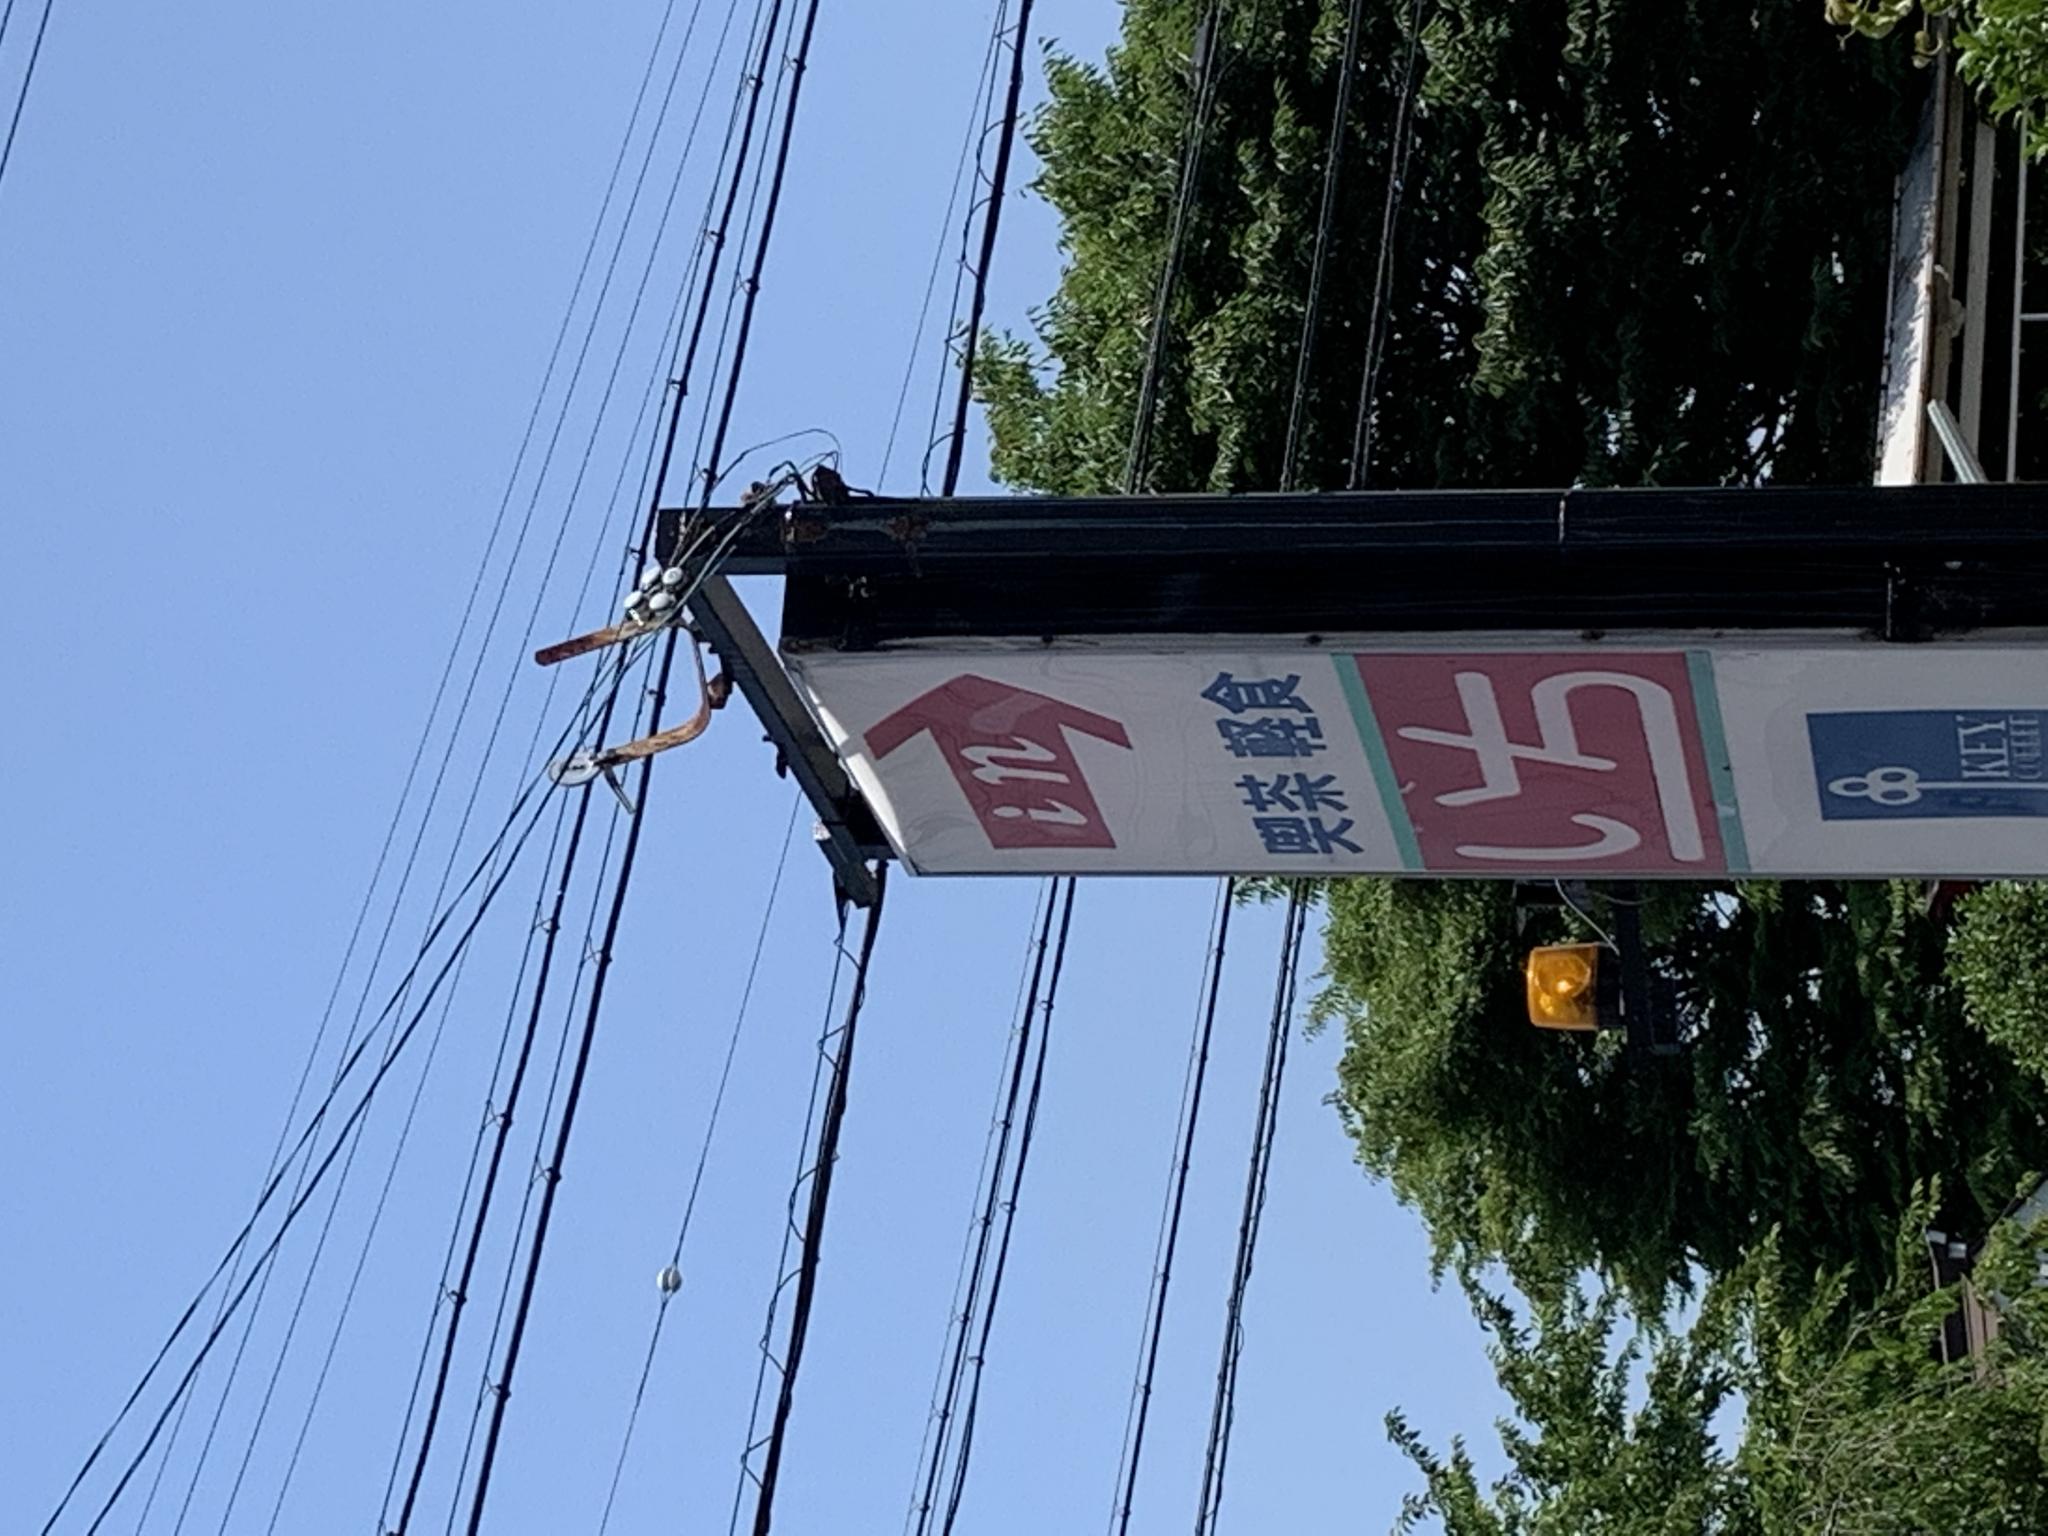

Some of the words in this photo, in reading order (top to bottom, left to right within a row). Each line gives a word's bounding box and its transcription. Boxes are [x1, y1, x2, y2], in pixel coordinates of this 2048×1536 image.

[1201, 671, 1328, 759] 軽食
[1955, 714, 2010, 779] KEY
[960, 735, 1088, 829] in
[1234, 771, 1364, 856] 喫茶
